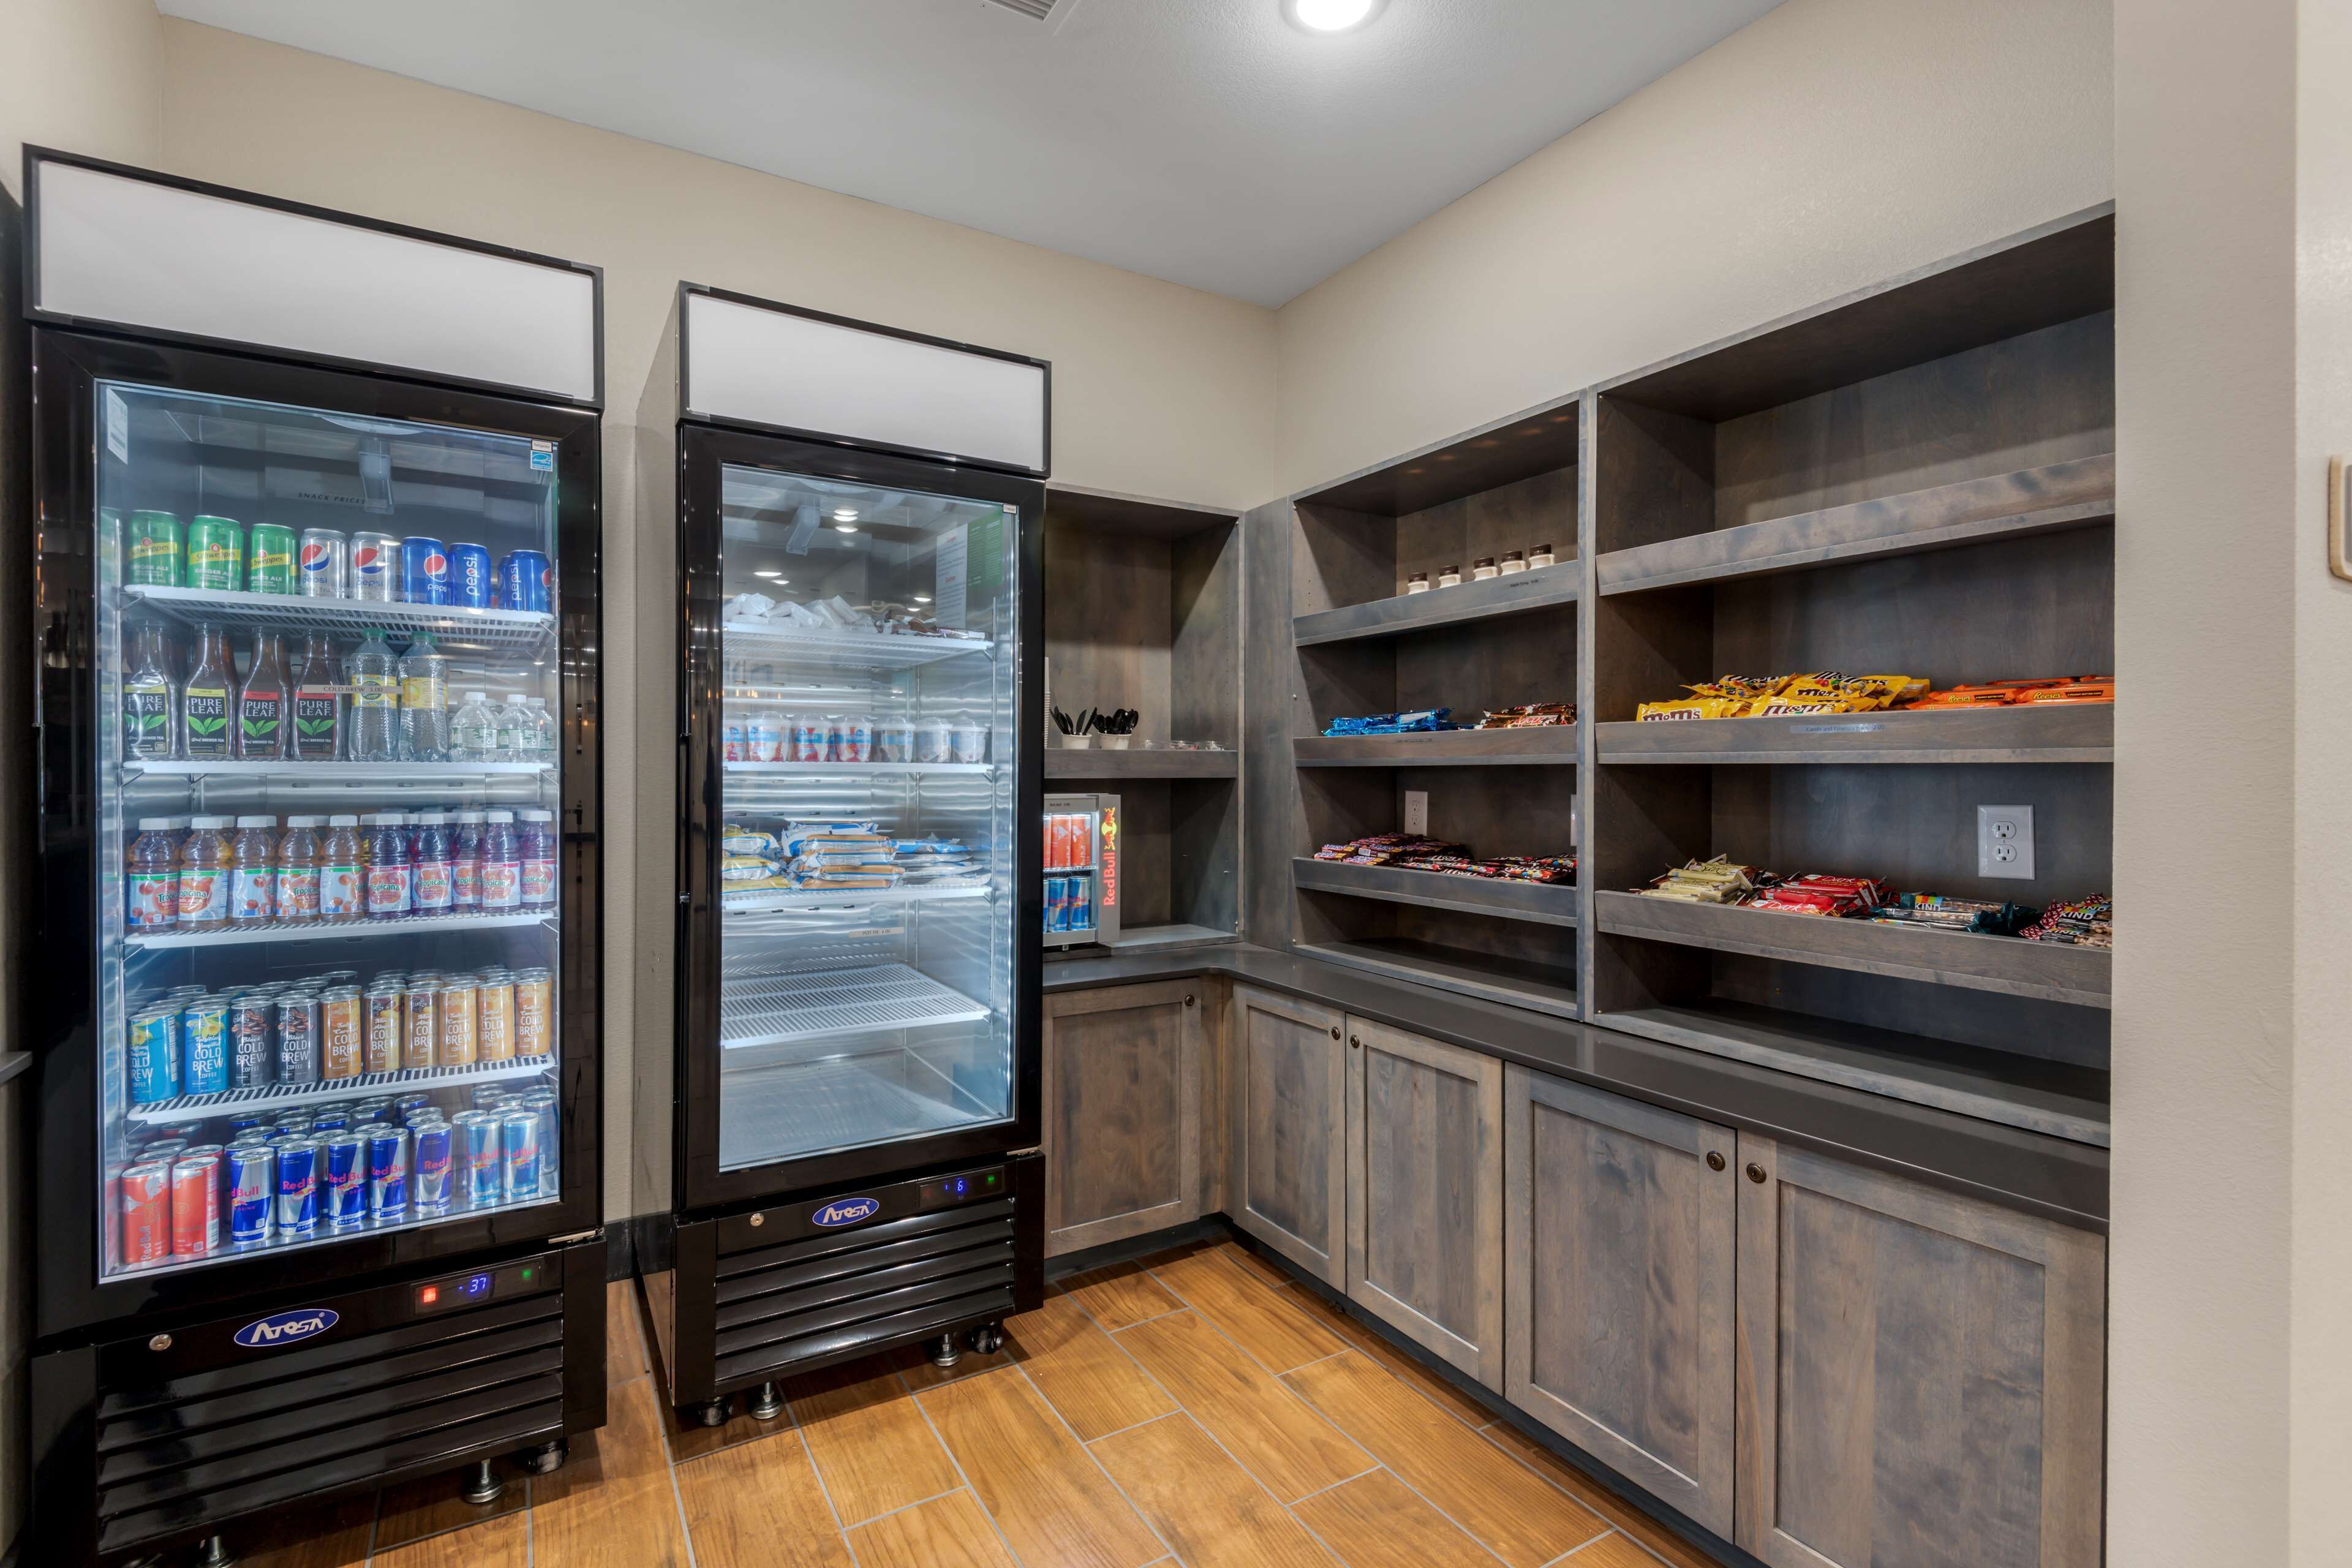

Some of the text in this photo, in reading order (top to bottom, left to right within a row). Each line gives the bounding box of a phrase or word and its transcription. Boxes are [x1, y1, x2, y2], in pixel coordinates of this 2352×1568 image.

[298, 492, 366, 505] SNACK PRICES
[463, 556, 481, 597] pepsi
[509, 563, 522, 601] pepsi
[191, 698, 222, 706] PURE
[246, 701, 275, 709] PURE
[300, 700, 331, 709] PURE
[1104, 852, 1115, 906] Red Bull
[1767, 902, 1804, 913] Dark
[1915, 903, 1941, 911] KIND
[2059, 911, 2094, 920] KIND
[521, 1015, 543, 1025] COLD
[448, 1023, 470, 1034] COLD
[519, 1024, 545, 1037] BREW
[334, 1031, 358, 1045] COLD
[446, 1033, 472, 1046] BREW
[238, 1041, 265, 1054] COLD
[284, 1040, 307, 1051] COLD
[333, 1043, 359, 1057] BREW
[194, 1047, 222, 1060] COLD
[236, 1052, 266, 1066] BREW
[282, 1050, 309, 1064] BREW
[192, 1057, 224, 1072] BREW
[132, 1068, 153, 1082] REW
[424, 1158, 445, 1170] Red
[282, 1177, 306, 1191] Red
[328, 1173, 347, 1183] Red
[236, 1185, 259, 1197] Bull
[957, 1180, 963, 1191] 6
[470, 1277, 487, 1292] 37
